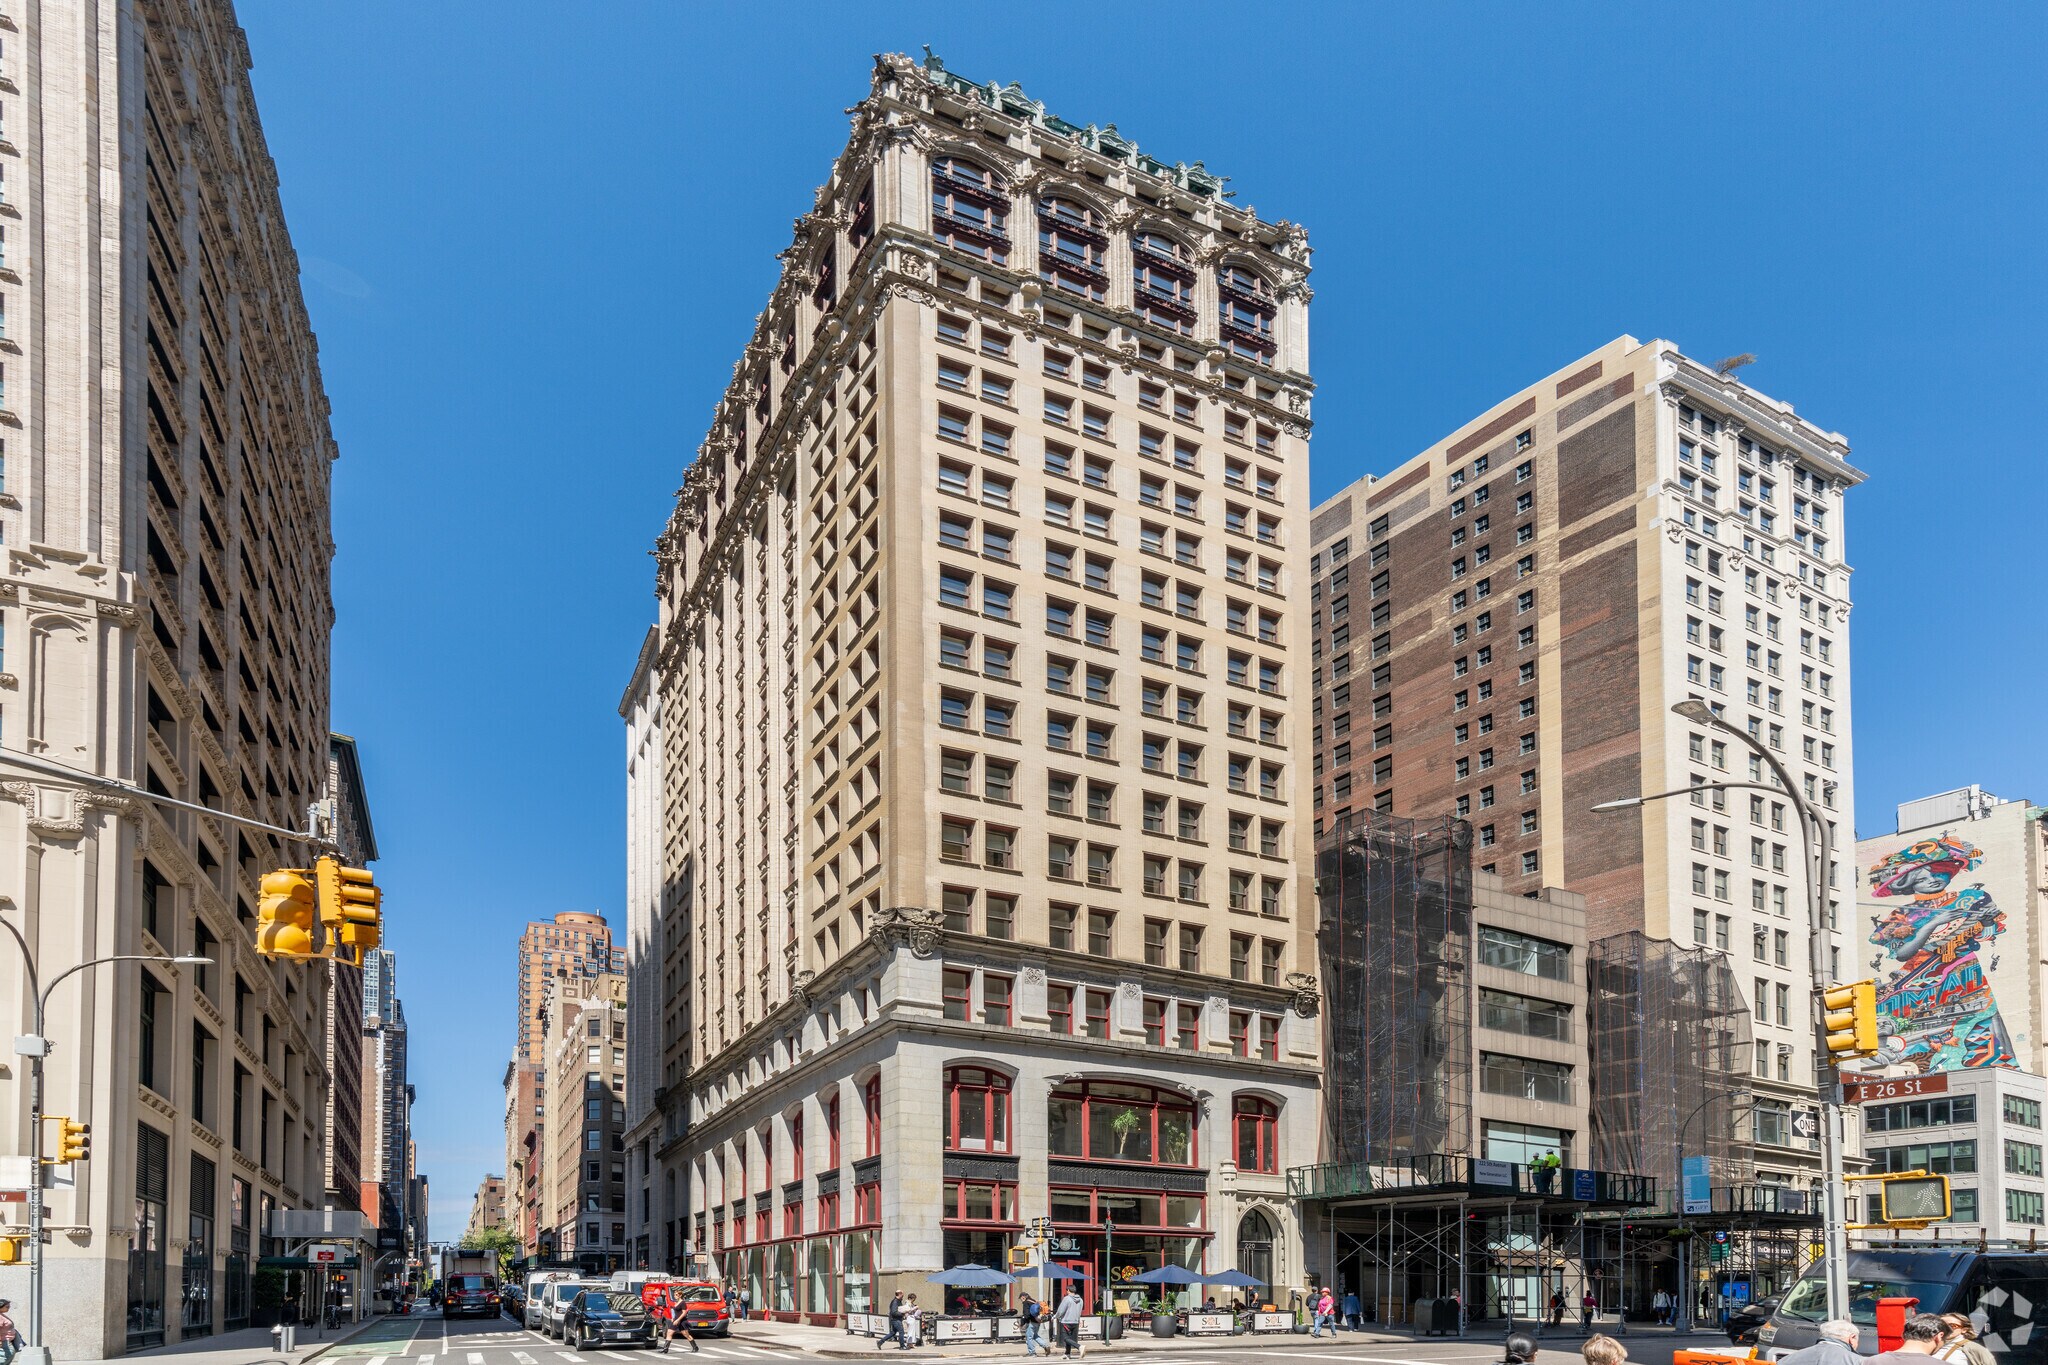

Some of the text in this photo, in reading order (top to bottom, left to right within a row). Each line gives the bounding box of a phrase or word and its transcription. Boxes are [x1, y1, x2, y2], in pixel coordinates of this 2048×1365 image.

[1861, 1086, 1868, 1099] E
[1876, 1083, 1896, 1097] 26
[1904, 1080, 1922, 1094] St
[1800, 1119, 1815, 1131] ONE
[1051, 1237, 1080, 1250] SOL
[1202, 1317, 1220, 1325] SOL
[1265, 1315, 1282, 1324] SOL
[952, 1322, 976, 1332] SOL
